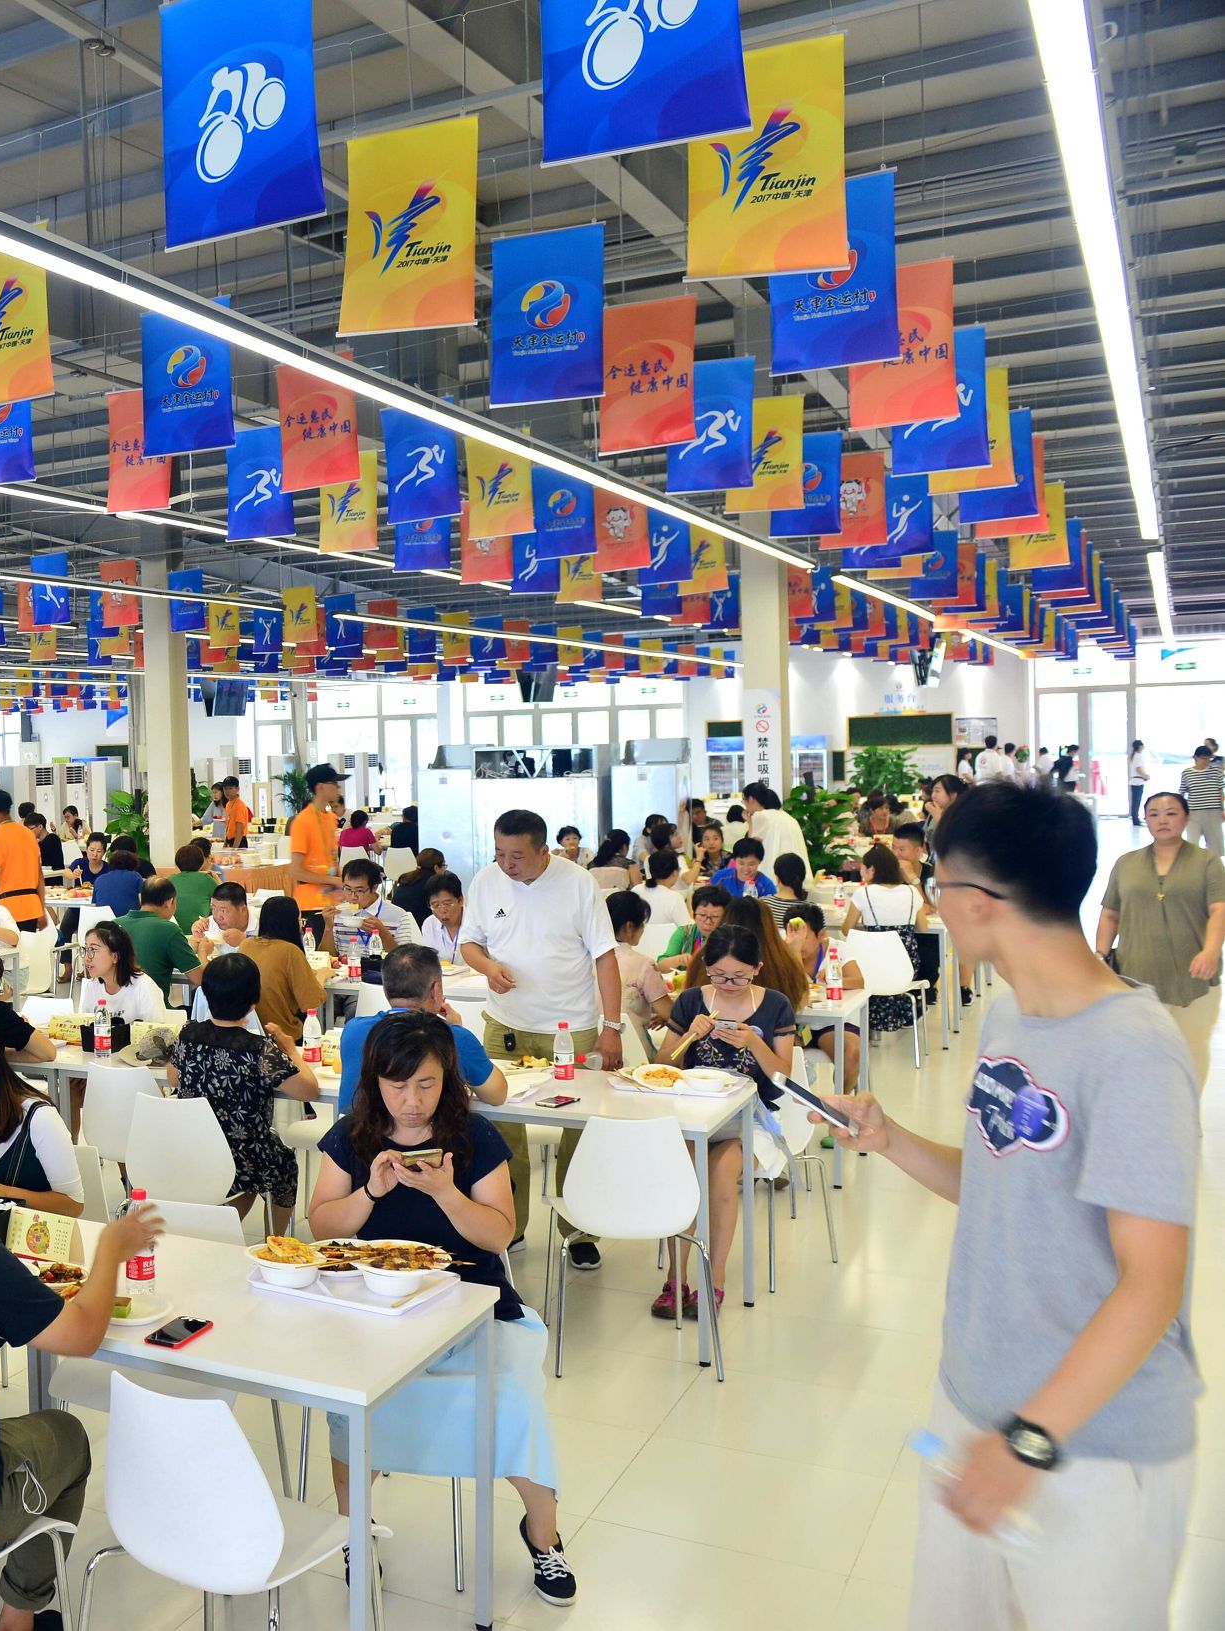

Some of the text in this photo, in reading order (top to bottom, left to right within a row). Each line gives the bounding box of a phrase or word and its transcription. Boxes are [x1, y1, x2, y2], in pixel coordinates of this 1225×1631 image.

[760, 172, 816, 191] Tianjin
[405, 240, 452, 258] Tianjin
[0, 326, 34, 341] Tianjin
[630, 372, 689, 396] 健康中国
[302, 420, 351, 441] 健康中国
[757, 737, 770, 789] 禁止吸烟
